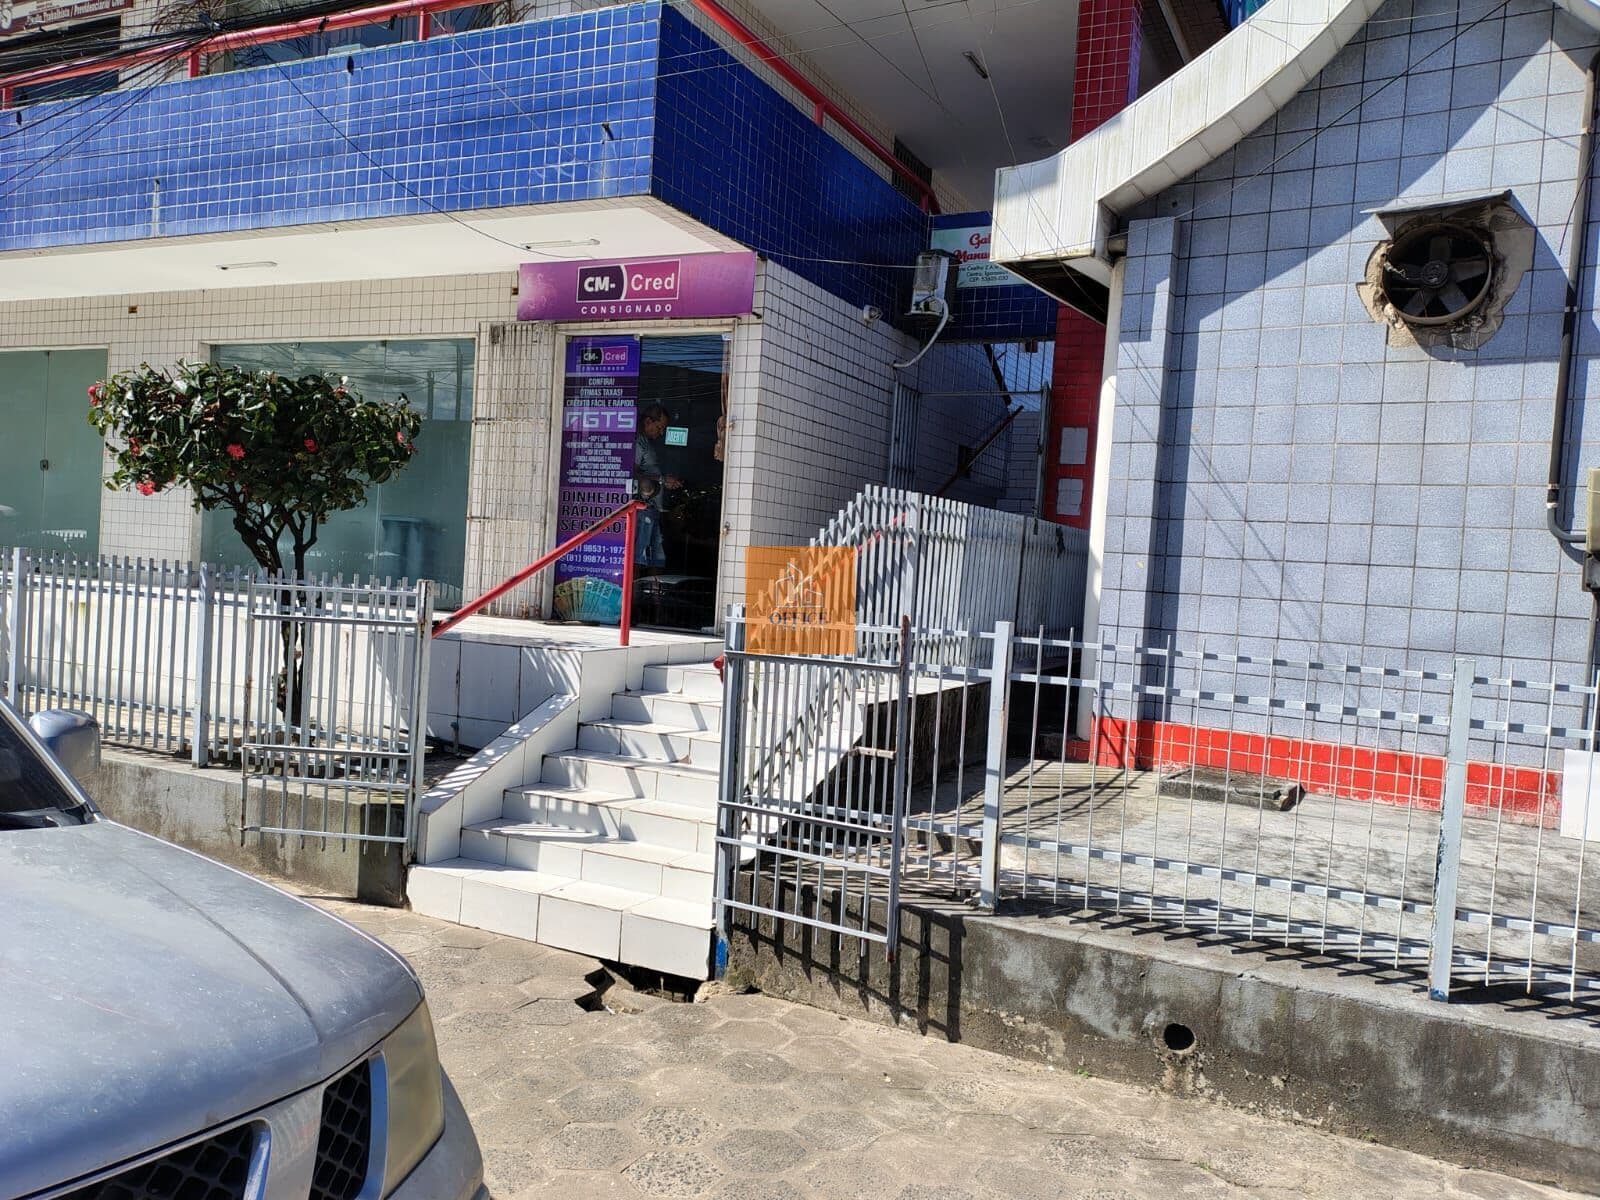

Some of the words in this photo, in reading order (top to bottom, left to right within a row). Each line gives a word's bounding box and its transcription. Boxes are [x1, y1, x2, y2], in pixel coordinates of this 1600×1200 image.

[630, 272, 675, 292] Cred
[581, 304, 673, 315] CONSIGNADO
[605, 351, 626, 361] Cred
[603, 388, 623, 396] TAXAS!
[565, 411, 634, 429] FGTS
[562, 490, 629, 505] DINHEIRO
